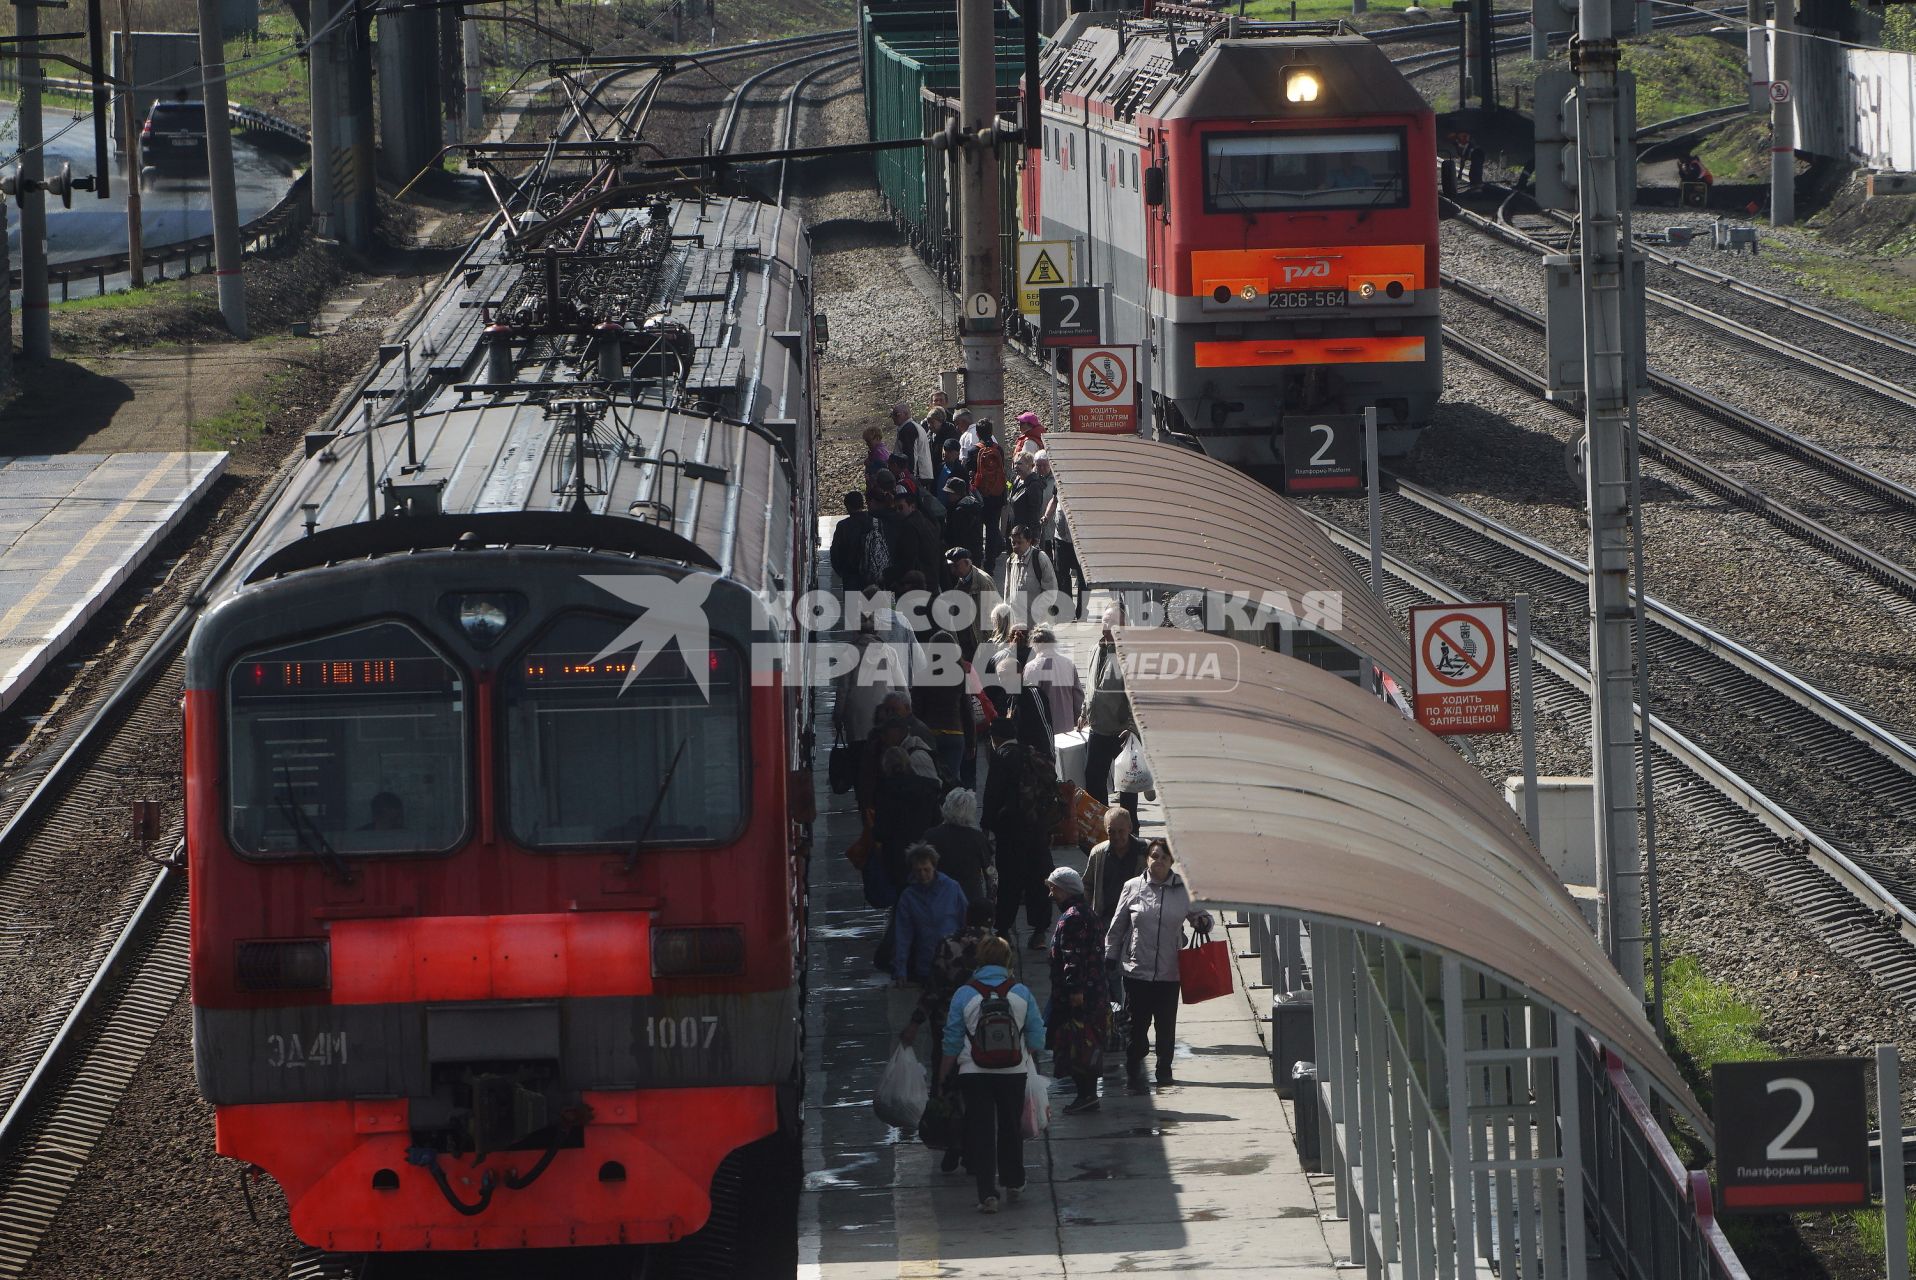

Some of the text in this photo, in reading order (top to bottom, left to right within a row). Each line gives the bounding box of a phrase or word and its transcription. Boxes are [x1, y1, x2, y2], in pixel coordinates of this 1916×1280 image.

[976, 294, 988, 316] С
[1060, 294, 1081, 328] 2
[1309, 424, 1336, 466] 2
[1426, 704, 1499, 716] ПО Ж/Д ПУТЯМ
[1442, 695, 1482, 705] ХОДИТЬ
[1429, 715, 1496, 726] ЗАПРЕЩЕНО!
[646, 1015, 718, 1049] 1007
[267, 1031, 347, 1068] ЭД4М
[1766, 1077, 1818, 1161] 2
[1737, 1163, 1850, 1179] Платформа Platform
